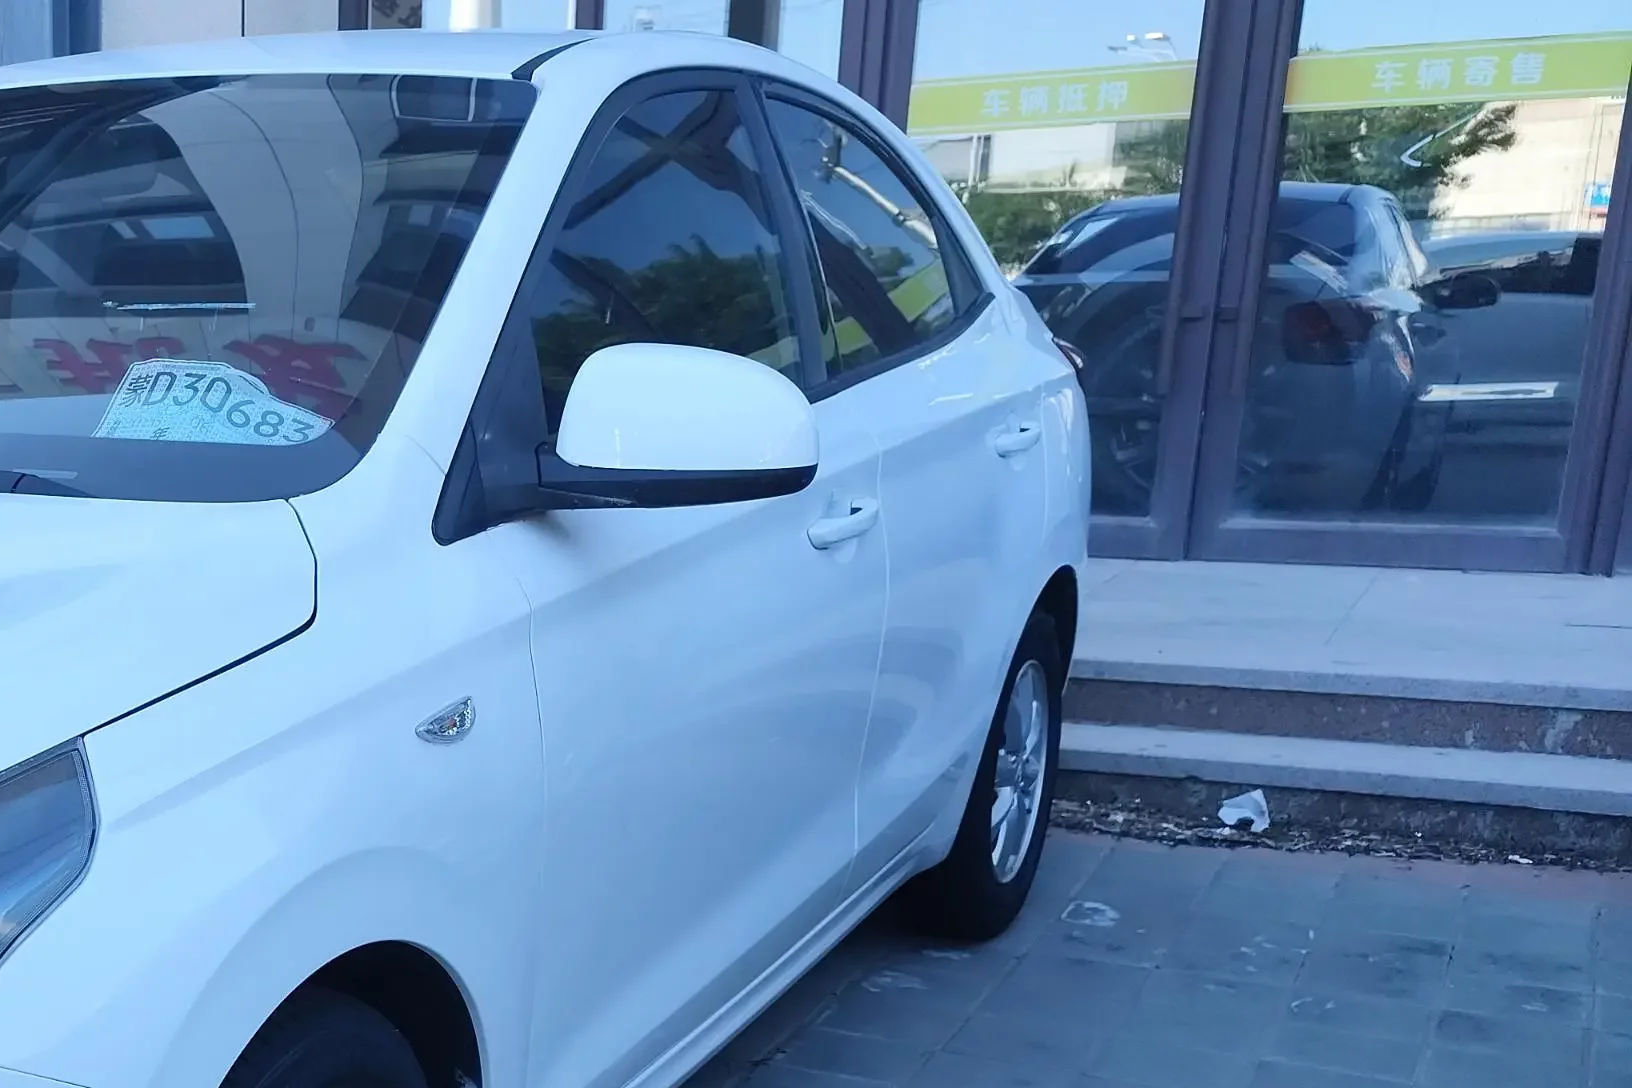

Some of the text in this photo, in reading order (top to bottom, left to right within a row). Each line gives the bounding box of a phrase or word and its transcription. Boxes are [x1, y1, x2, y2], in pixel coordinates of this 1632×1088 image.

[1370, 52, 1546, 94] 车辆寄售
[980, 79, 1129, 118] 车辆抵押
[120, 370, 316, 444] 蒙D30683
